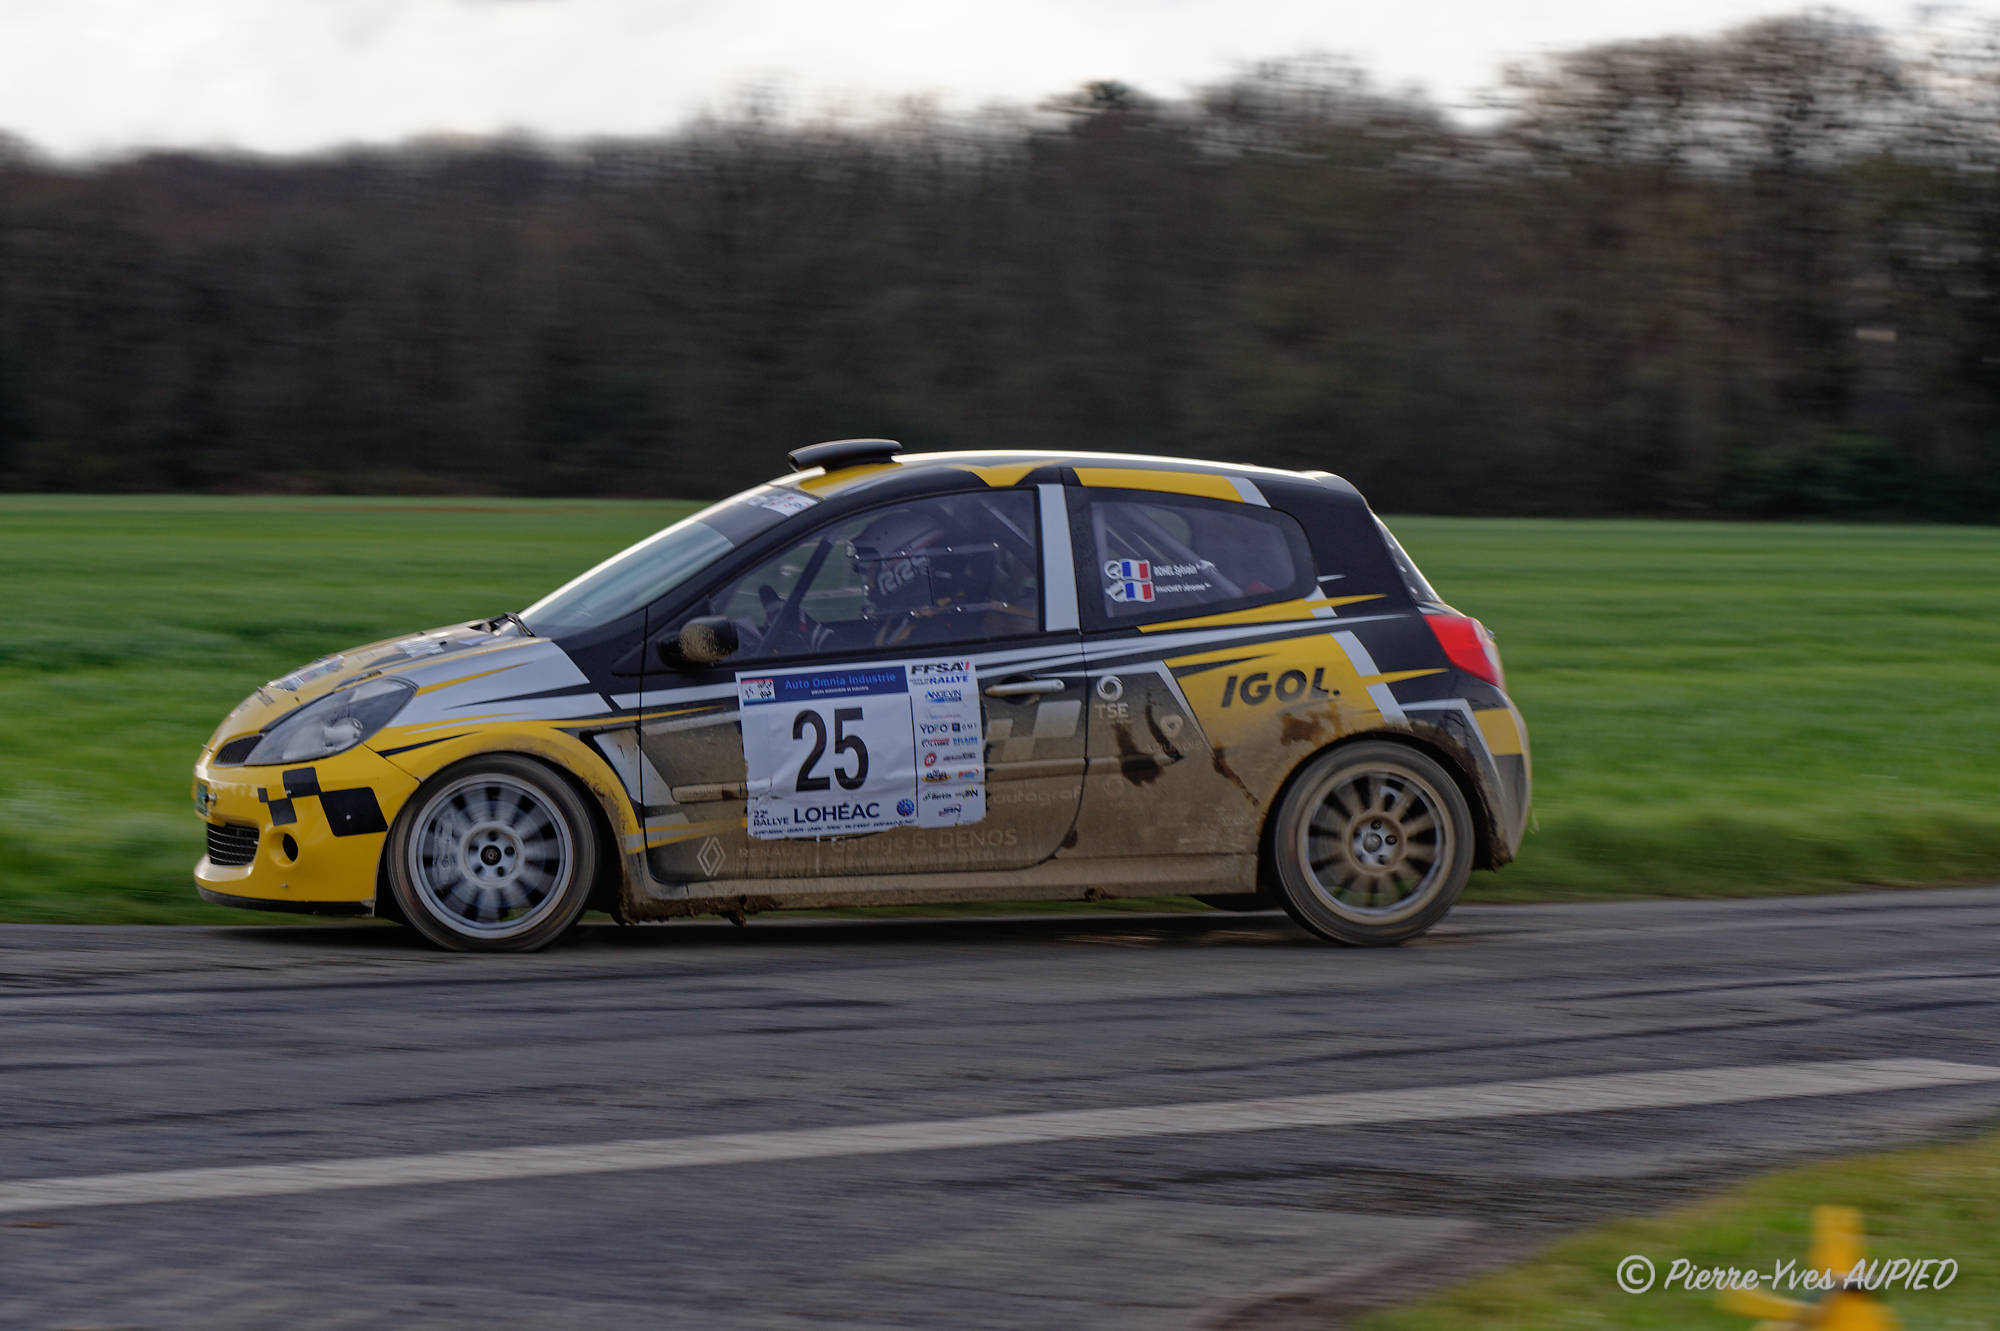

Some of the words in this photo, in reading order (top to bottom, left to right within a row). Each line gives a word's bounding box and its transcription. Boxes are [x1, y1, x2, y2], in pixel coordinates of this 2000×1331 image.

[911, 661, 966, 674] FFSA
[784, 679, 810, 690] Auto
[812, 675, 846, 688] Omnia
[849, 672, 896, 685] Industrie
[929, 675, 968, 685] RALLYE
[1094, 702, 1129, 718] TSE
[792, 706, 869, 792] 25
[753, 816, 790, 827] RALLYE
[793, 802, 881, 824] LOHÉAC
[939, 828, 1018, 848] DENOS
